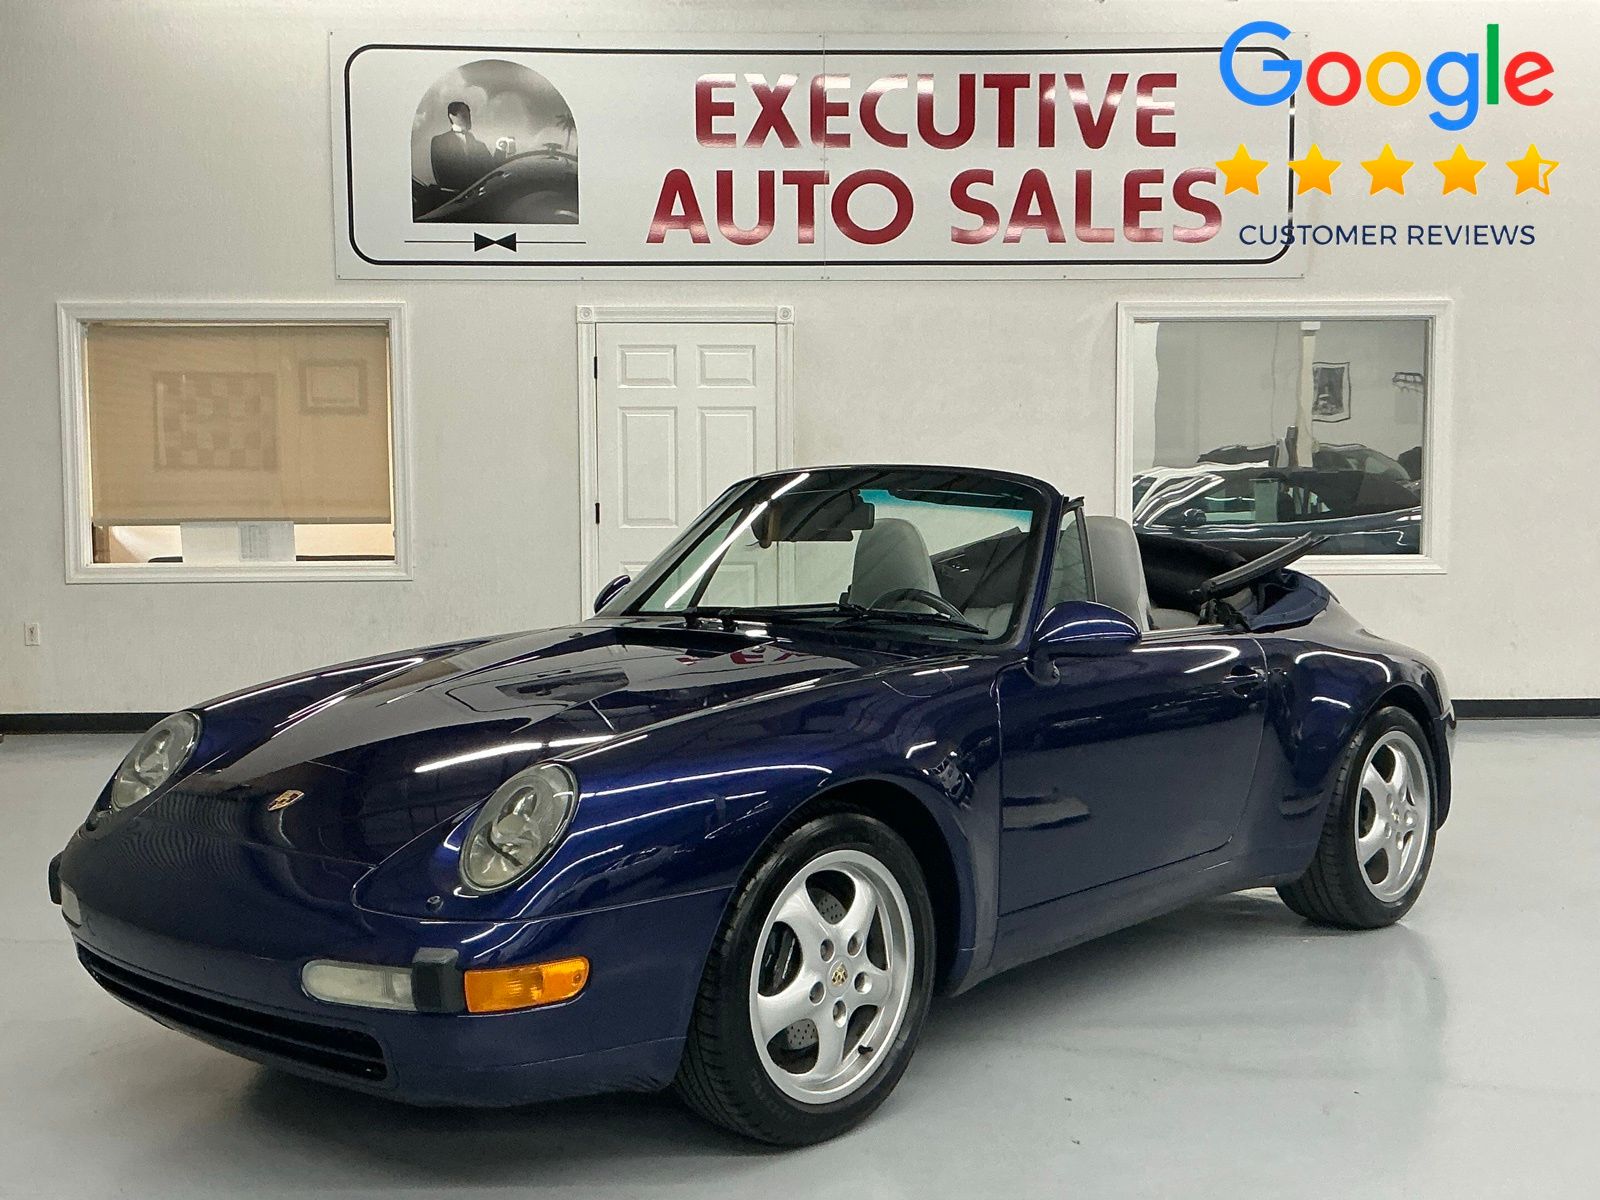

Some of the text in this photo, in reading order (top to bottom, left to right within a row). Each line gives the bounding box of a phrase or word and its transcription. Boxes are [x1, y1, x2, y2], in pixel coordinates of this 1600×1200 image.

[695, 72, 1177, 149] EXECUTIVE
[646, 168, 1222, 245] AUTO SALES
